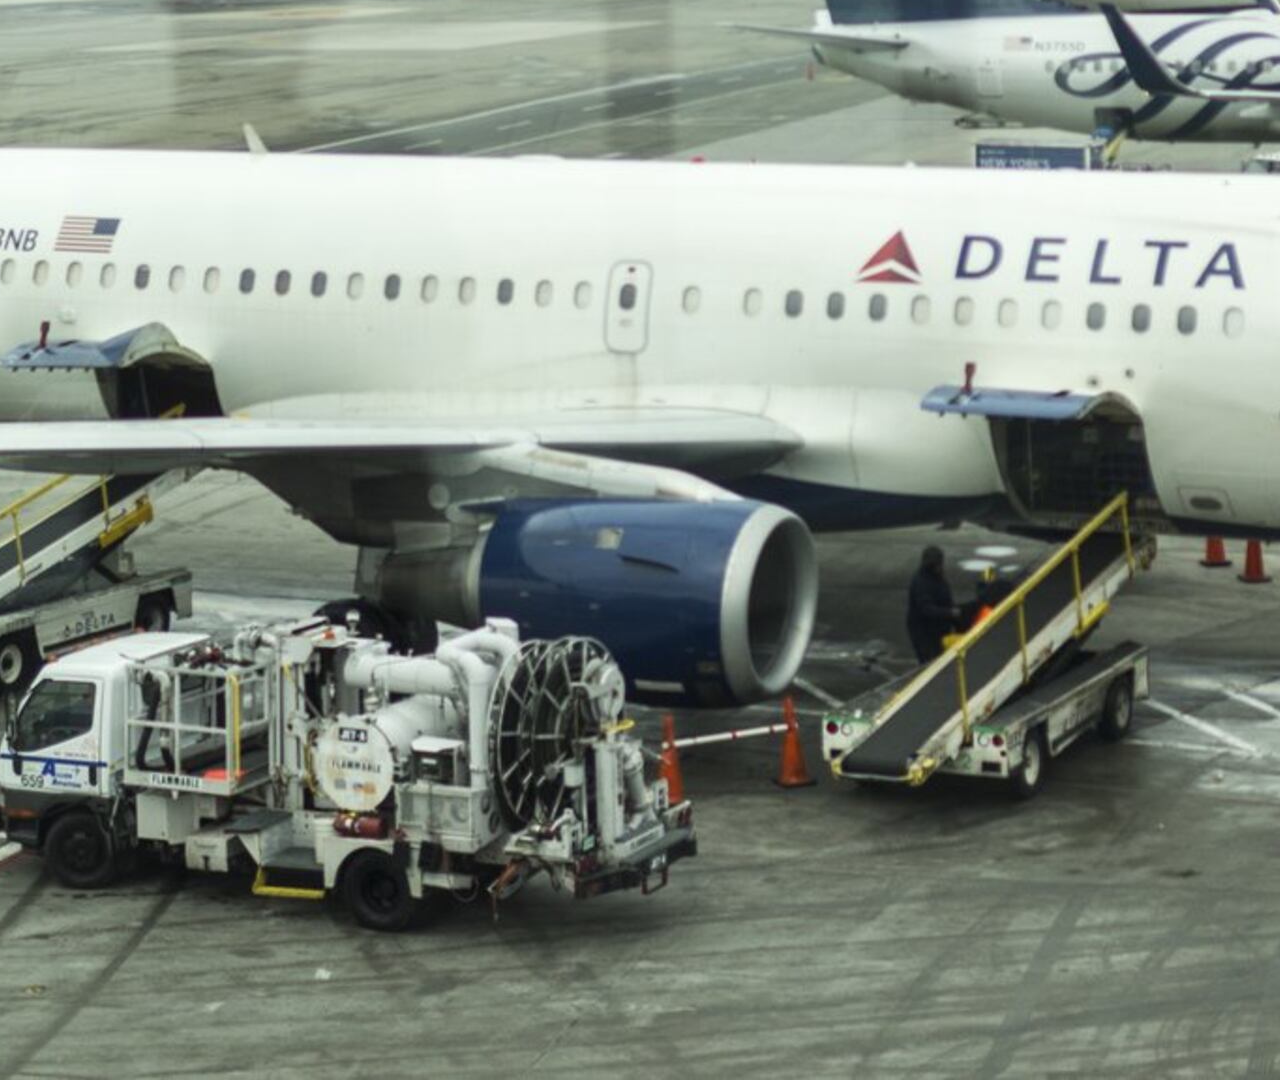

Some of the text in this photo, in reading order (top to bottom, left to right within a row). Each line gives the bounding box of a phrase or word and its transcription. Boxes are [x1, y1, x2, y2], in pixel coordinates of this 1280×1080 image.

[954, 234, 1246, 291] DELTA
[75, 612, 116, 634] DELTA
[21, 773, 45, 788] 659
